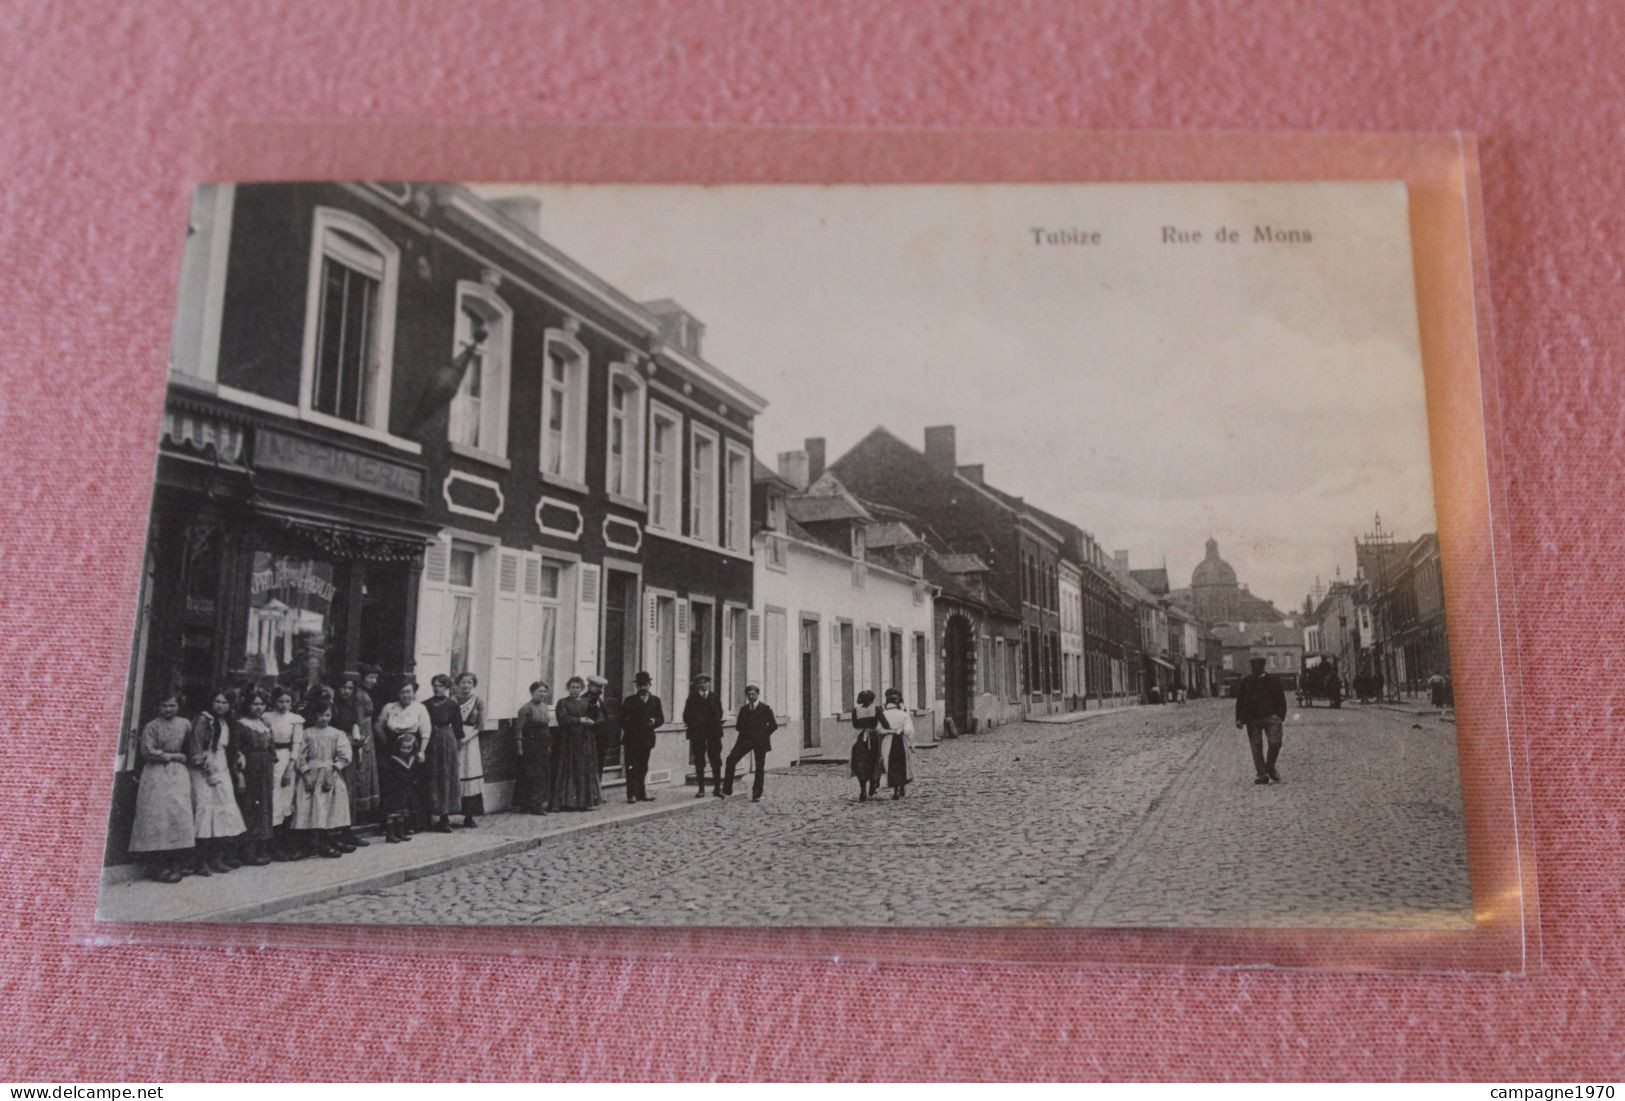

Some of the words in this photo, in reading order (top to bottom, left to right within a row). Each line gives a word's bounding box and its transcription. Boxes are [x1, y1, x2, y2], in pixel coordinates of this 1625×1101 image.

[1031, 227, 1102, 246] Tubize
[1161, 225, 1202, 244] Rue
[1215, 225, 1240, 244] de
[1253, 225, 1313, 244] Mons
